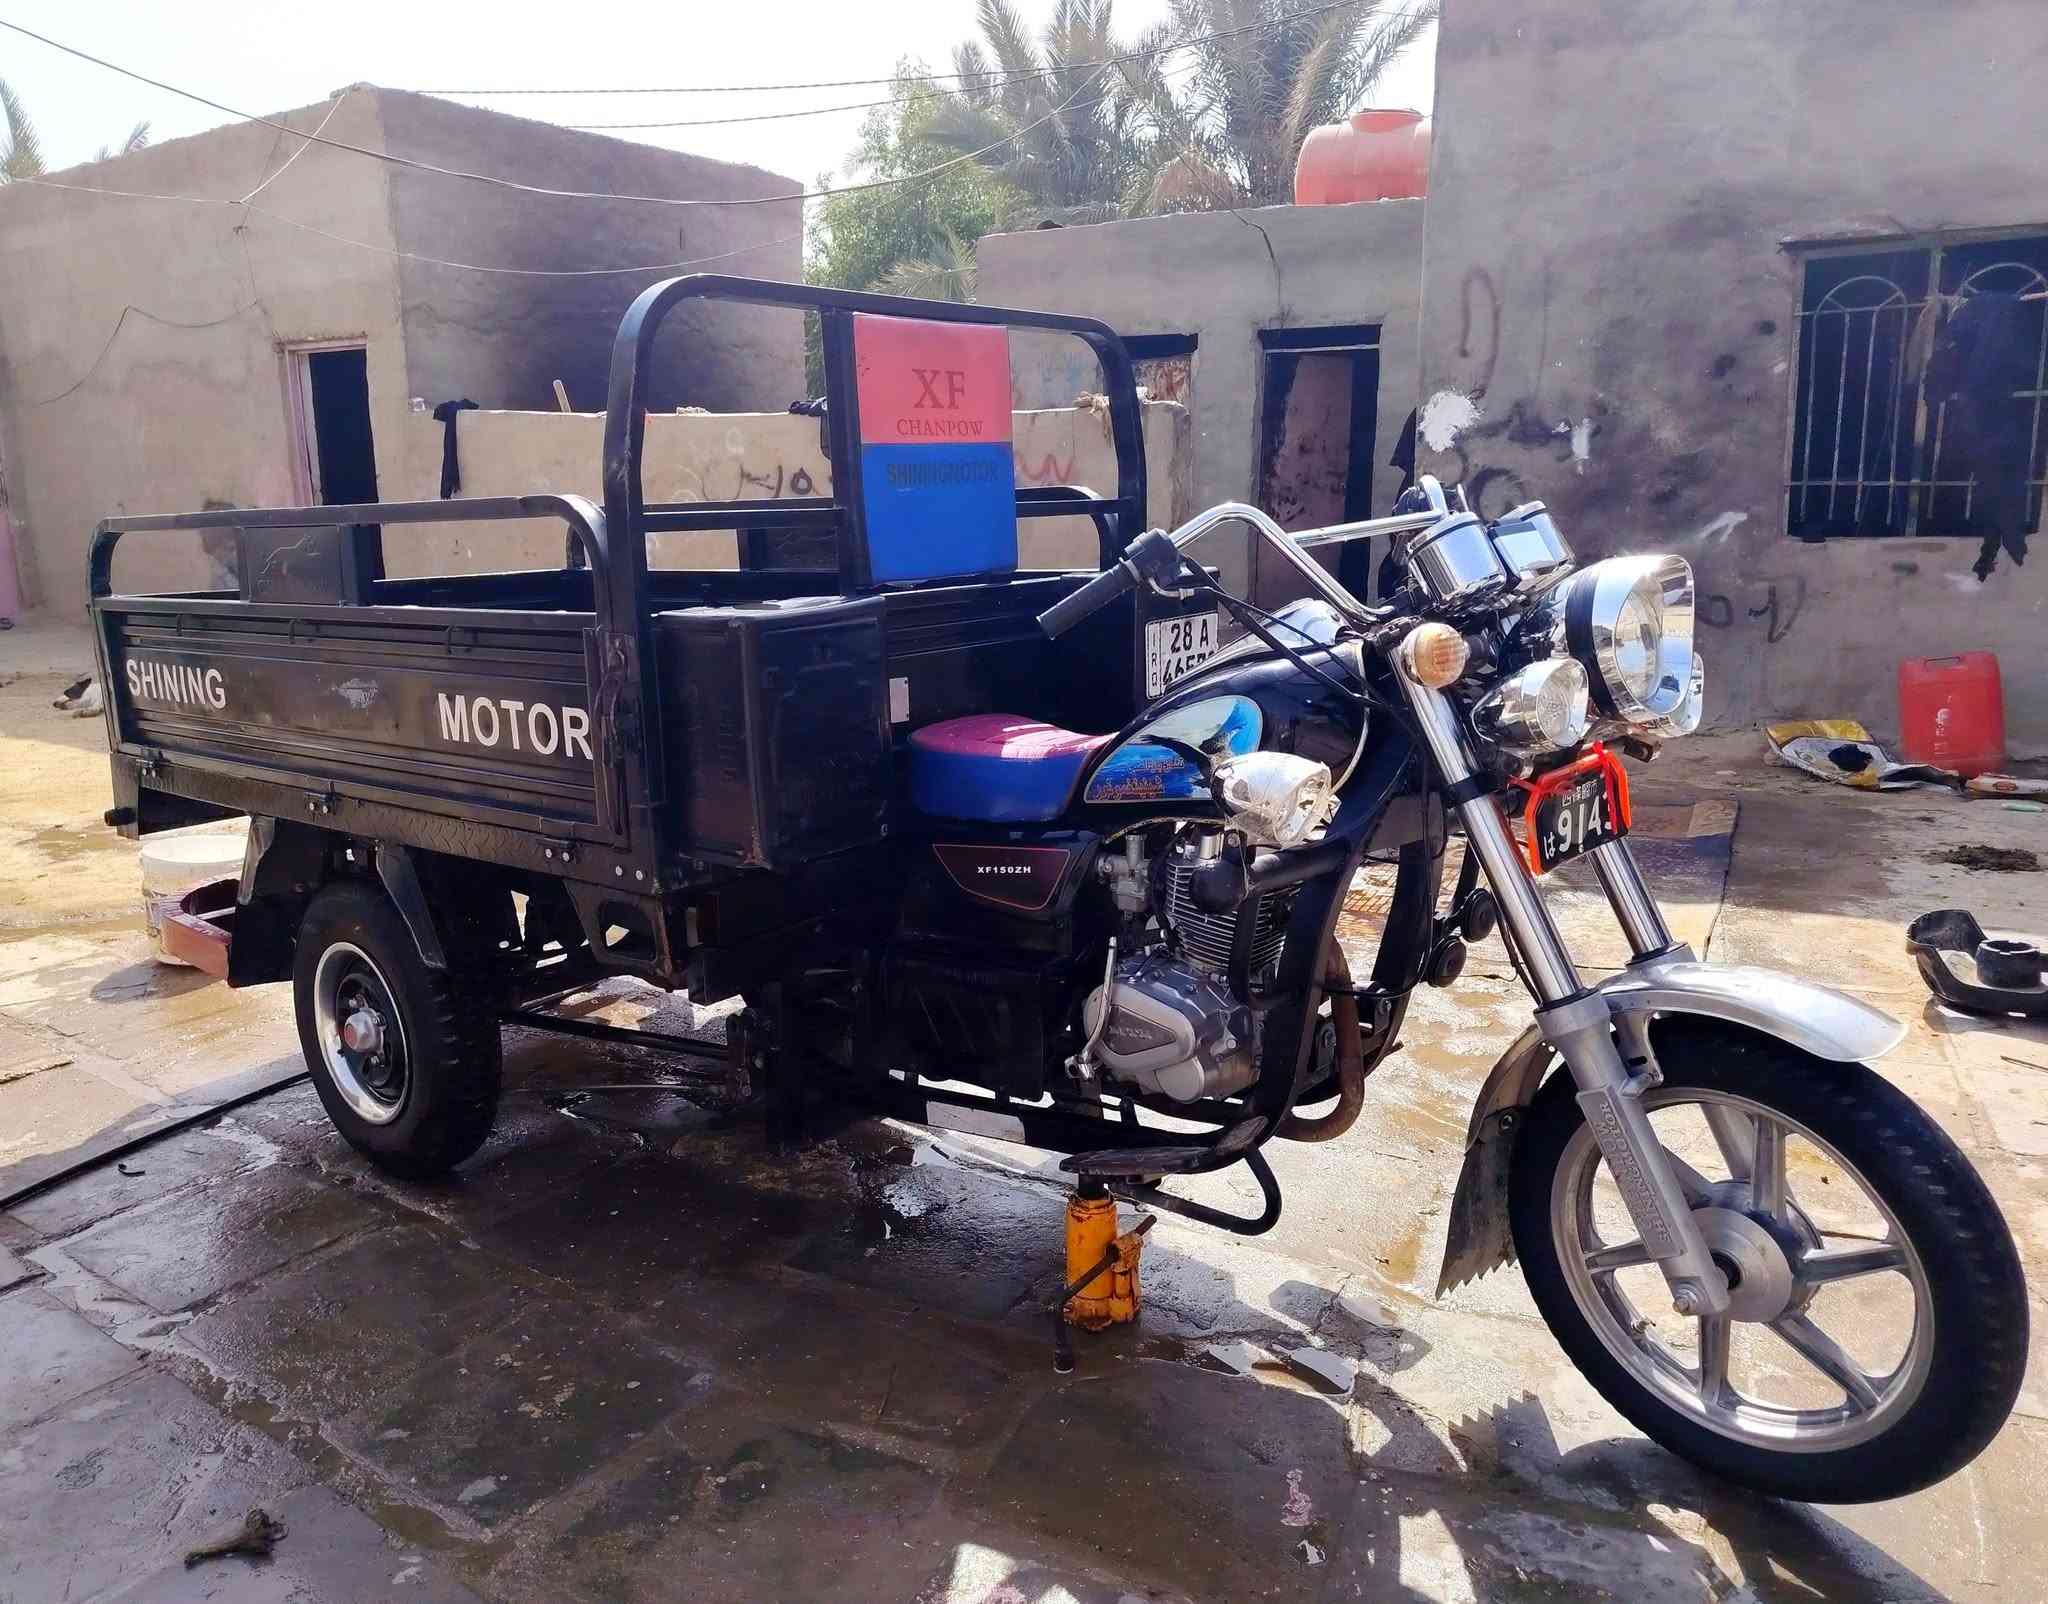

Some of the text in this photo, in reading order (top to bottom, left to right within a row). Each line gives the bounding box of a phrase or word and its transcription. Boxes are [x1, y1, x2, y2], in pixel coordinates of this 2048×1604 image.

[911, 368, 966, 410] XF
[896, 418, 984, 437] CHANPOW
[1170, 618, 1209, 654] 28 A
[126, 658, 594, 760] SHINING MOTOR
[976, 866, 1032, 874] XF150ZH
